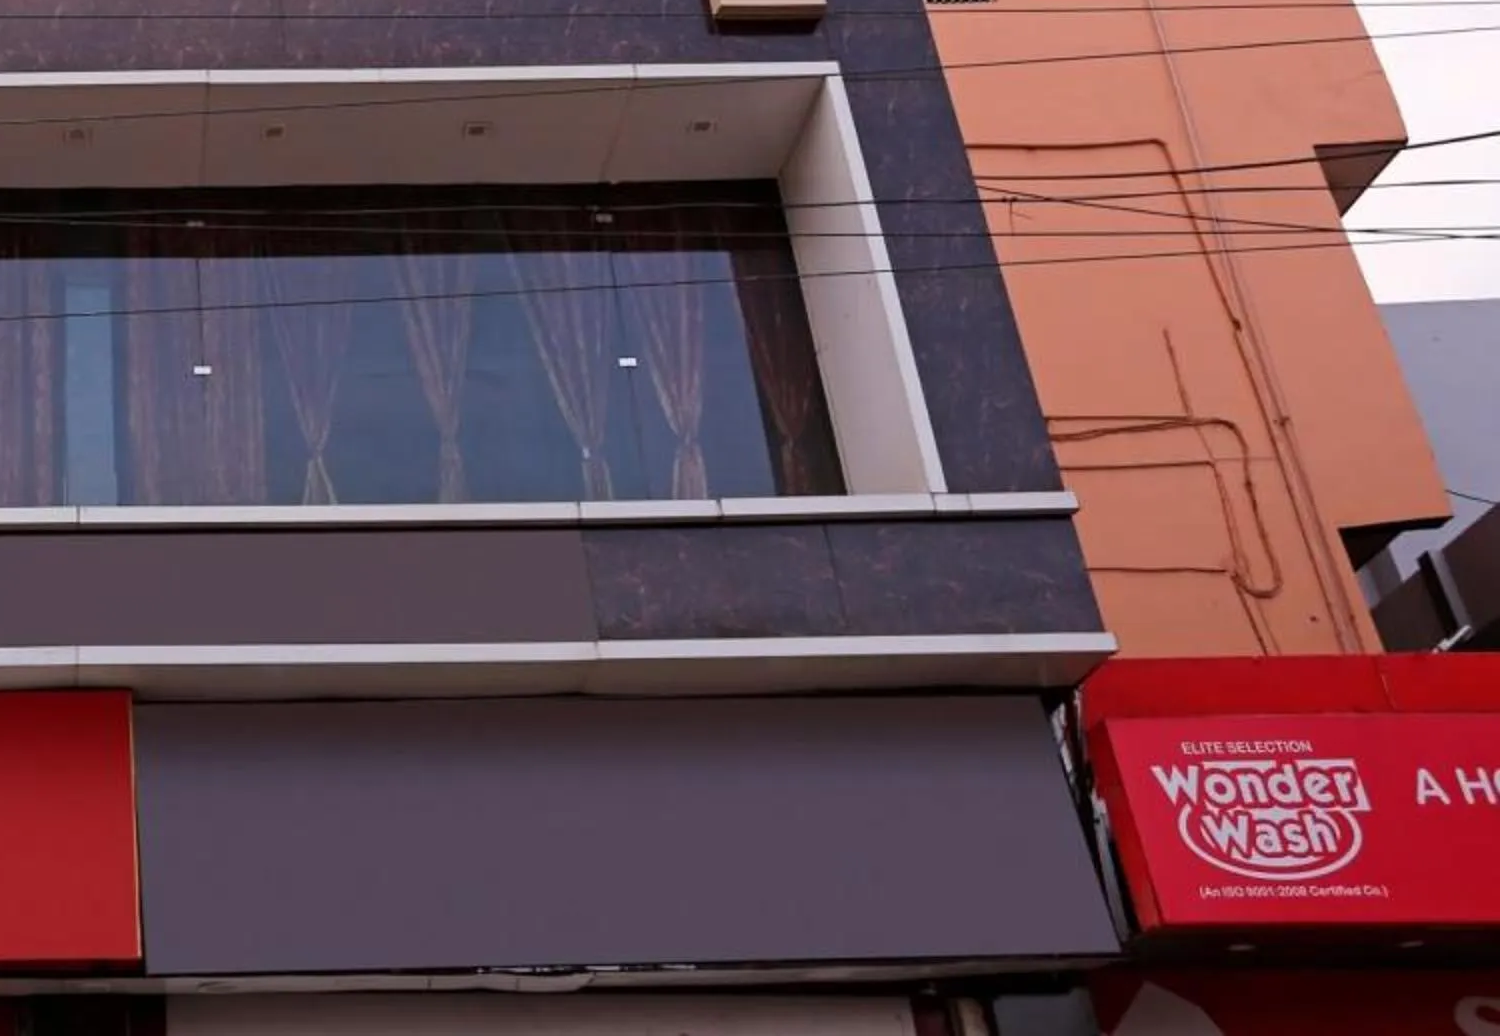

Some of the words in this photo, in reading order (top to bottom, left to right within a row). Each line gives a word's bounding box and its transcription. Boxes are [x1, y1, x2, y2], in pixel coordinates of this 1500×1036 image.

[1181, 741, 1224, 754] ELITE
[1226, 740, 1313, 754] SELECTION
[1151, 763, 1353, 806] Wonder
[1416, 767, 1451, 805] A
[1201, 812, 1337, 854] Wash
